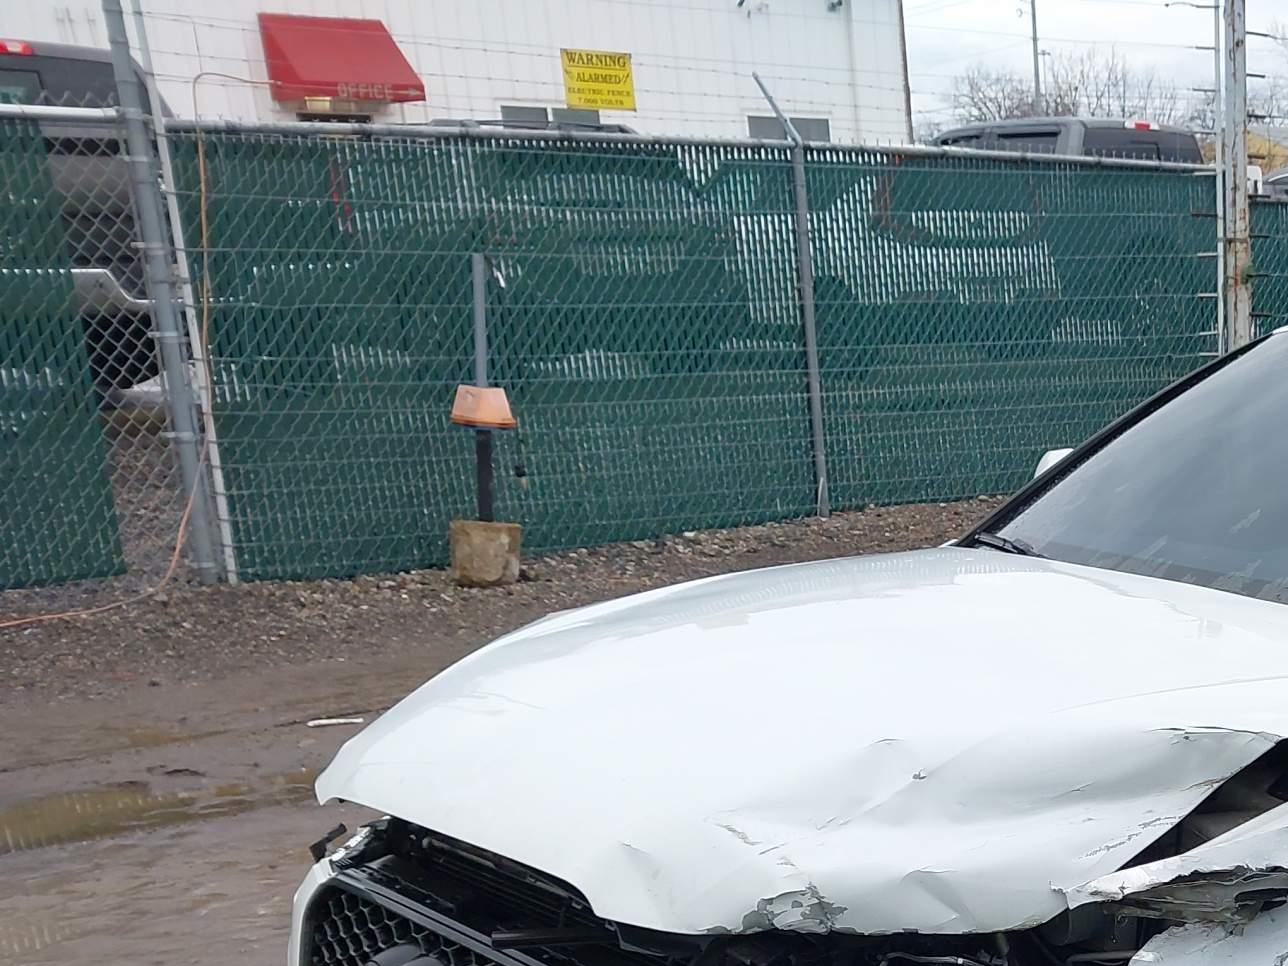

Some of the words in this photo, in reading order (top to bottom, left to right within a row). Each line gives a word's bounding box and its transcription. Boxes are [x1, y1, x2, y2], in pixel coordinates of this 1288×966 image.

[565, 51, 626, 68] WARNING
[575, 71, 621, 84] ALARMED
[336, 82, 393, 100] OFFICE
